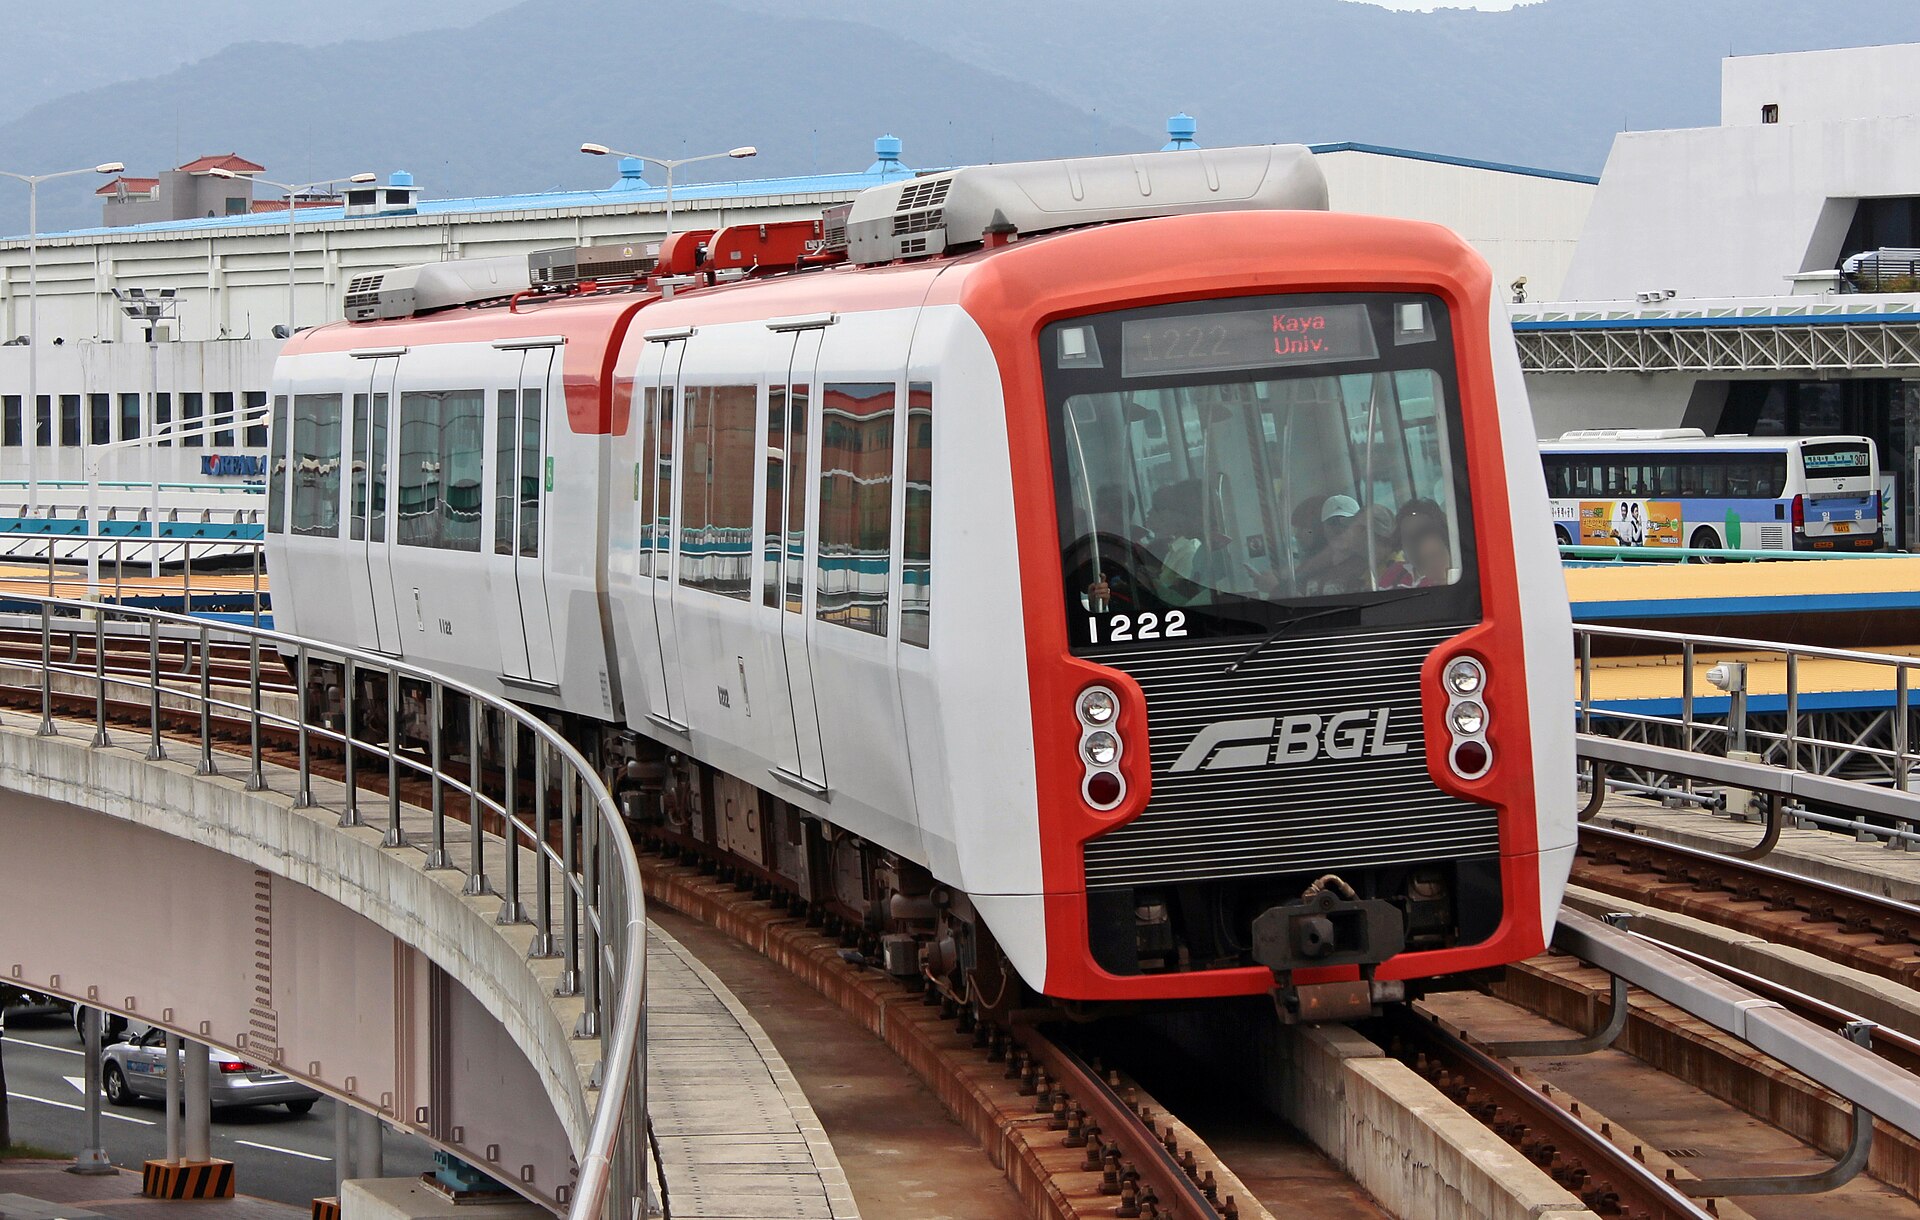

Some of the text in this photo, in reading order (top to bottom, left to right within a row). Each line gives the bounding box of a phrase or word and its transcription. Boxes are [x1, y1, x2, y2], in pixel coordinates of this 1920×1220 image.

[1272, 314, 1325, 334] Kaya
[1142, 324, 1230, 361] 1222
[1274, 335, 1329, 354] Univ.
[1854, 454, 1867, 466] 307
[1088, 610, 1188, 644] 1222
[1275, 707, 1408, 765] BGL
